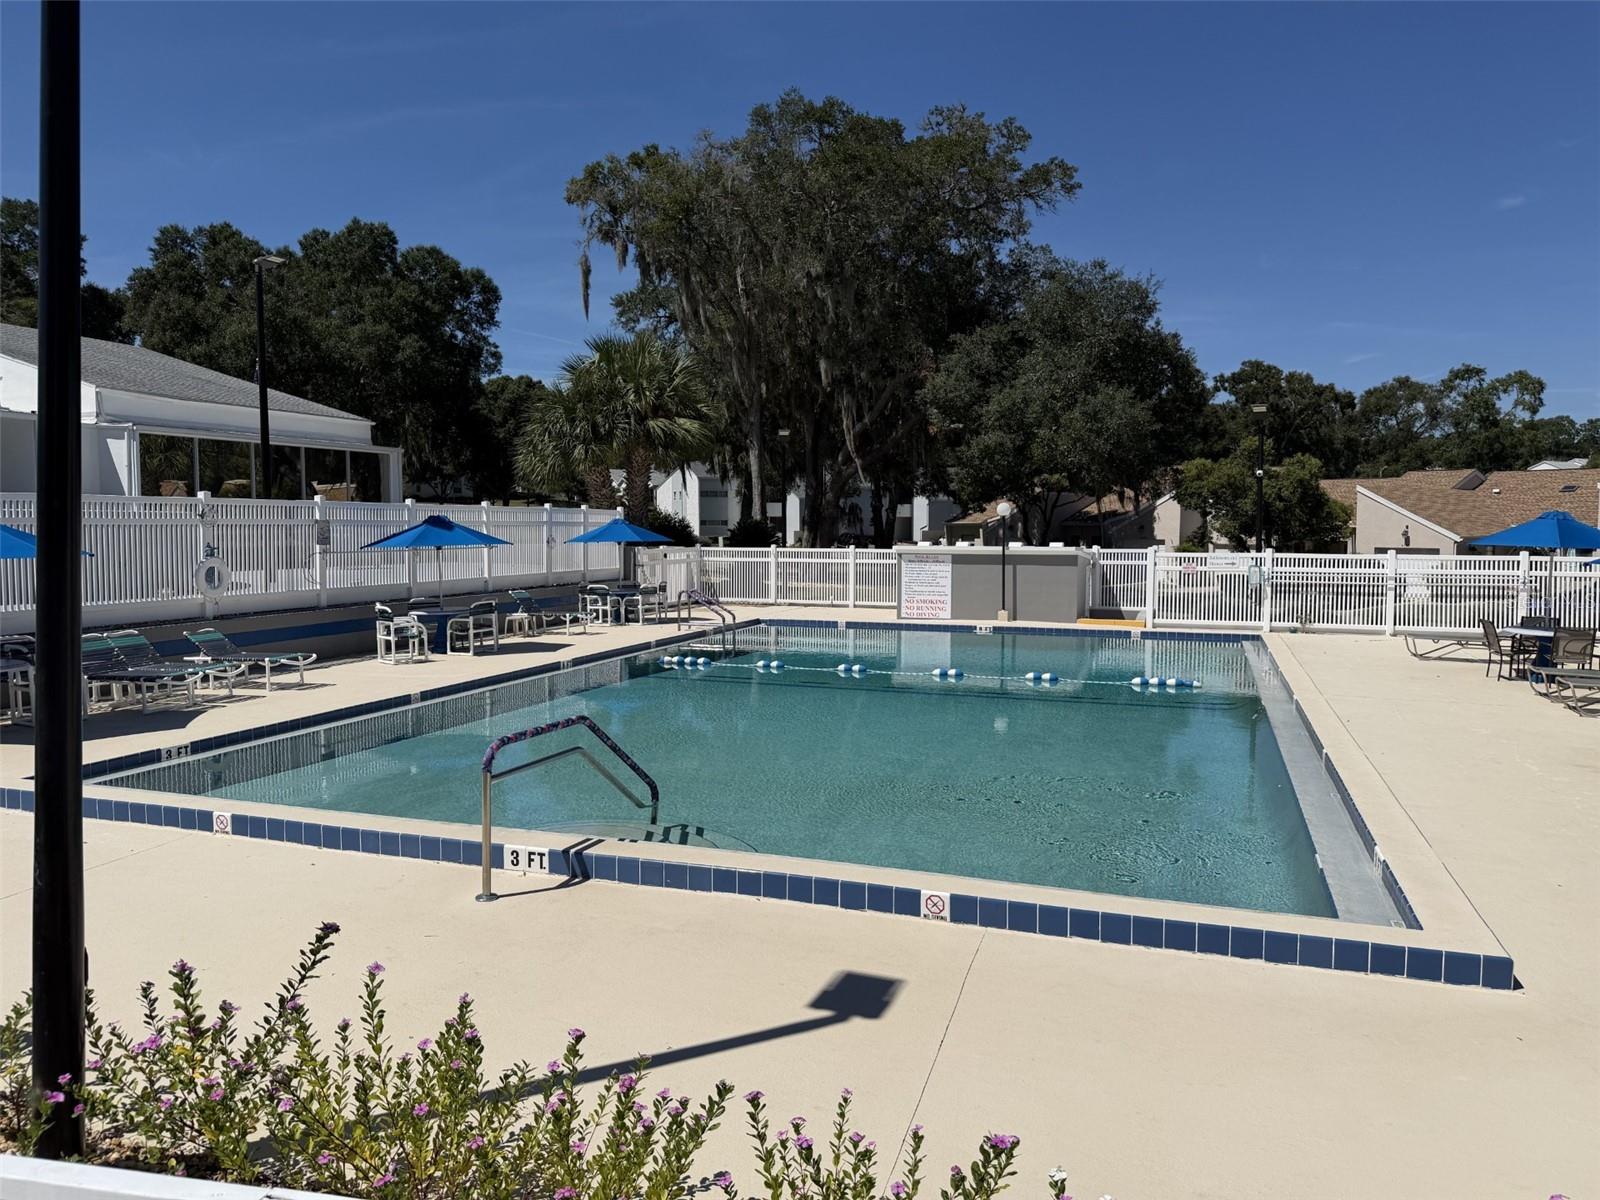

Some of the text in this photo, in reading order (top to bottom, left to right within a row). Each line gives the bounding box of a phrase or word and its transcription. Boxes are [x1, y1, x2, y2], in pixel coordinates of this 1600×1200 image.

[166, 749, 172, 760] 3
[510, 850, 546, 870] 3 FT.
